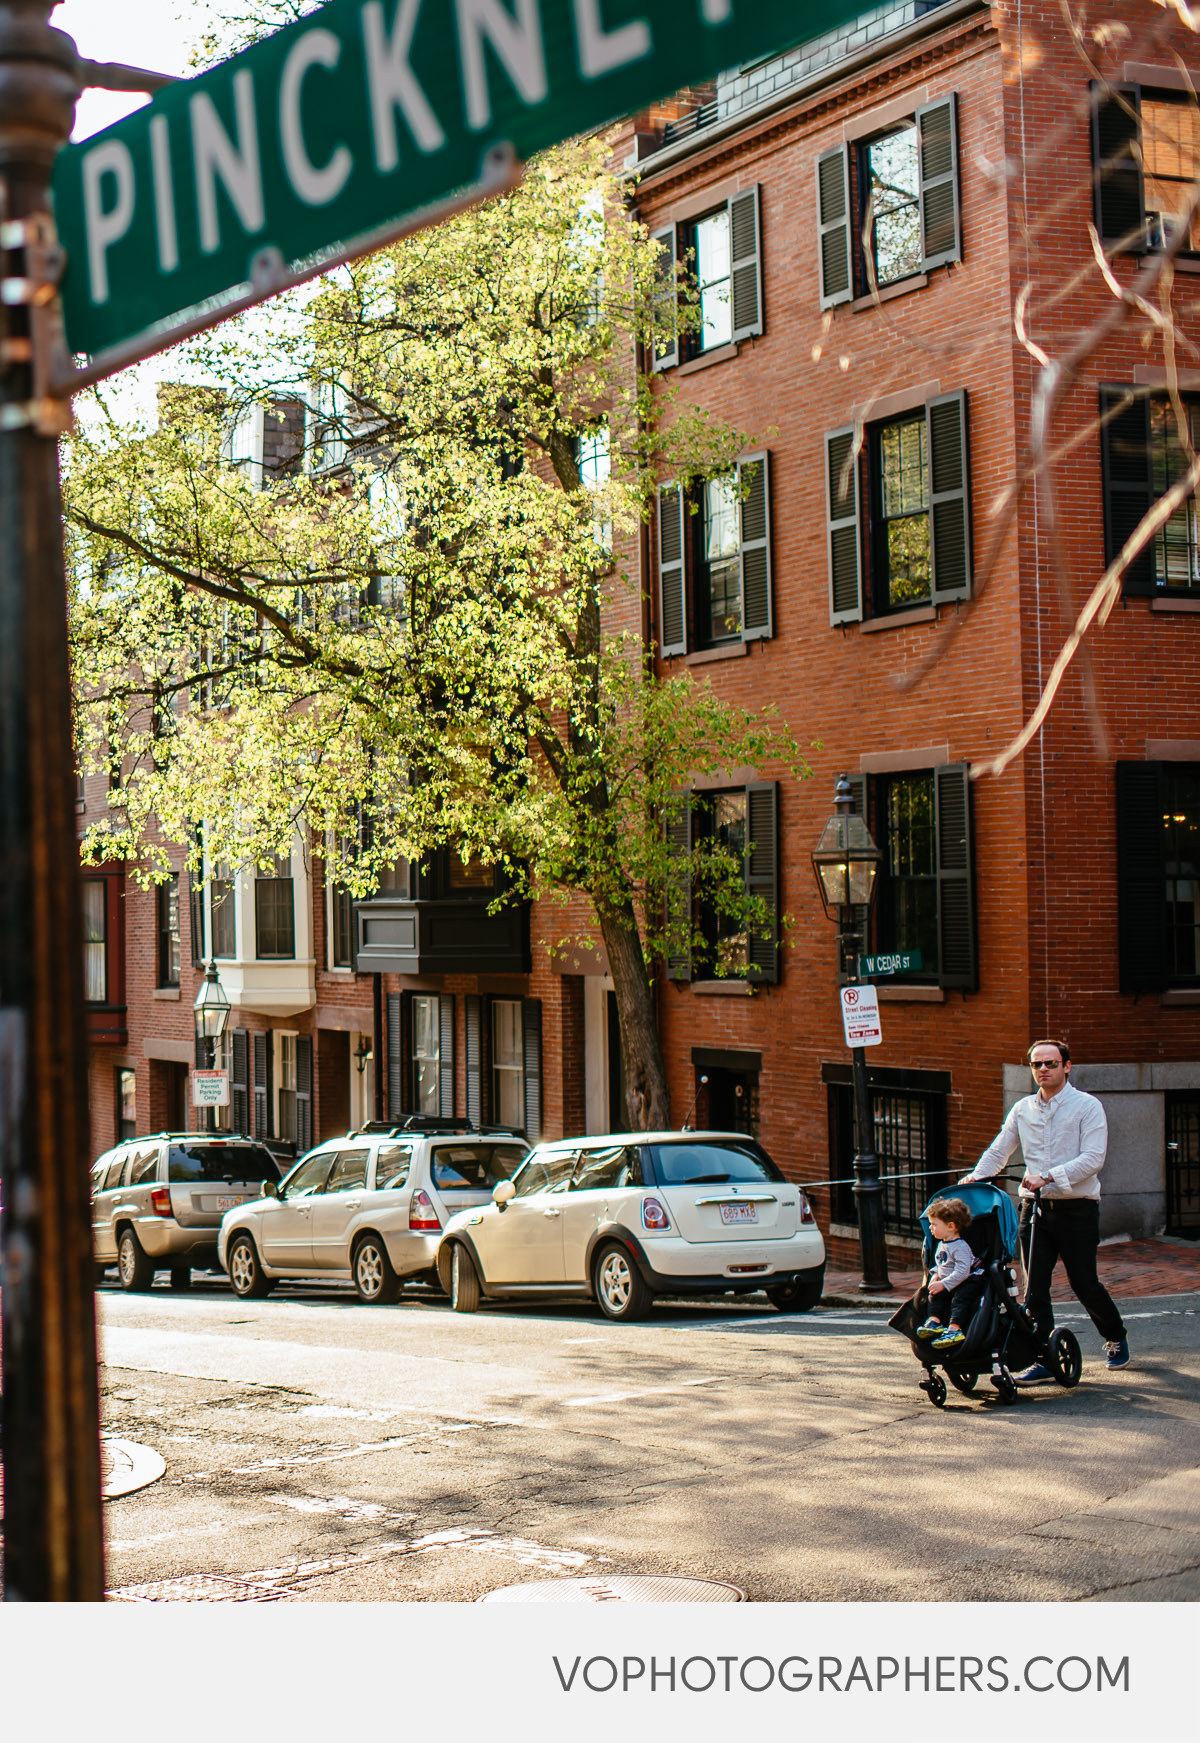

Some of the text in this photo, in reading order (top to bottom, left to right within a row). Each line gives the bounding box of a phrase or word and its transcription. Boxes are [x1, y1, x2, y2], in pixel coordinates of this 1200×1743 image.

[82, 0, 733, 304] PINCKN
[866, 954, 910, 972] W CEDAR ST
[723, 1207, 738, 1219] 689
